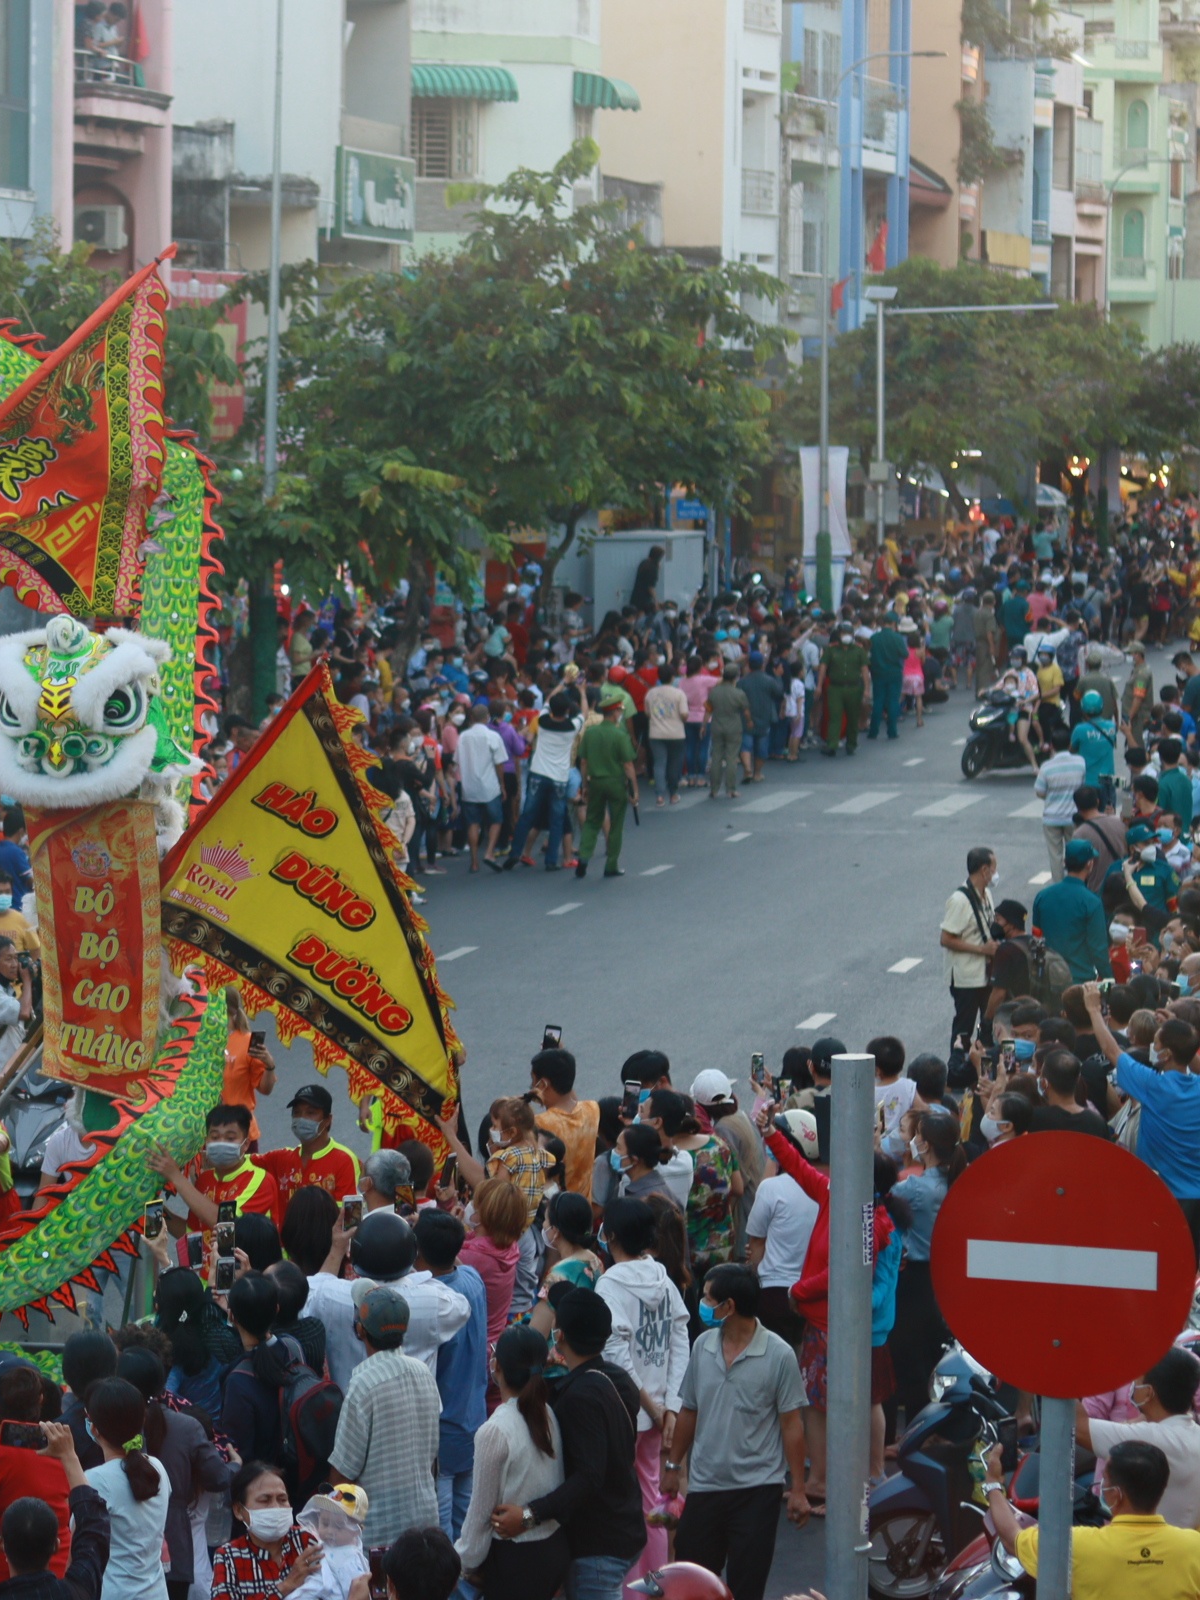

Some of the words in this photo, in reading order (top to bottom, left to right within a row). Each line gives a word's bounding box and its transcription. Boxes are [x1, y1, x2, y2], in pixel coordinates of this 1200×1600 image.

[252, 782, 338, 838] HÀO
[74, 882, 115, 923] BỘ
[184, 863, 238, 901] Royal
[270, 850, 376, 930] DŨNG
[78, 929, 120, 970] BỘ
[72, 978, 131, 1013] CAO
[286, 935, 413, 1035] ĐƯỜNG
[58, 1025, 147, 1071] THĂNG
